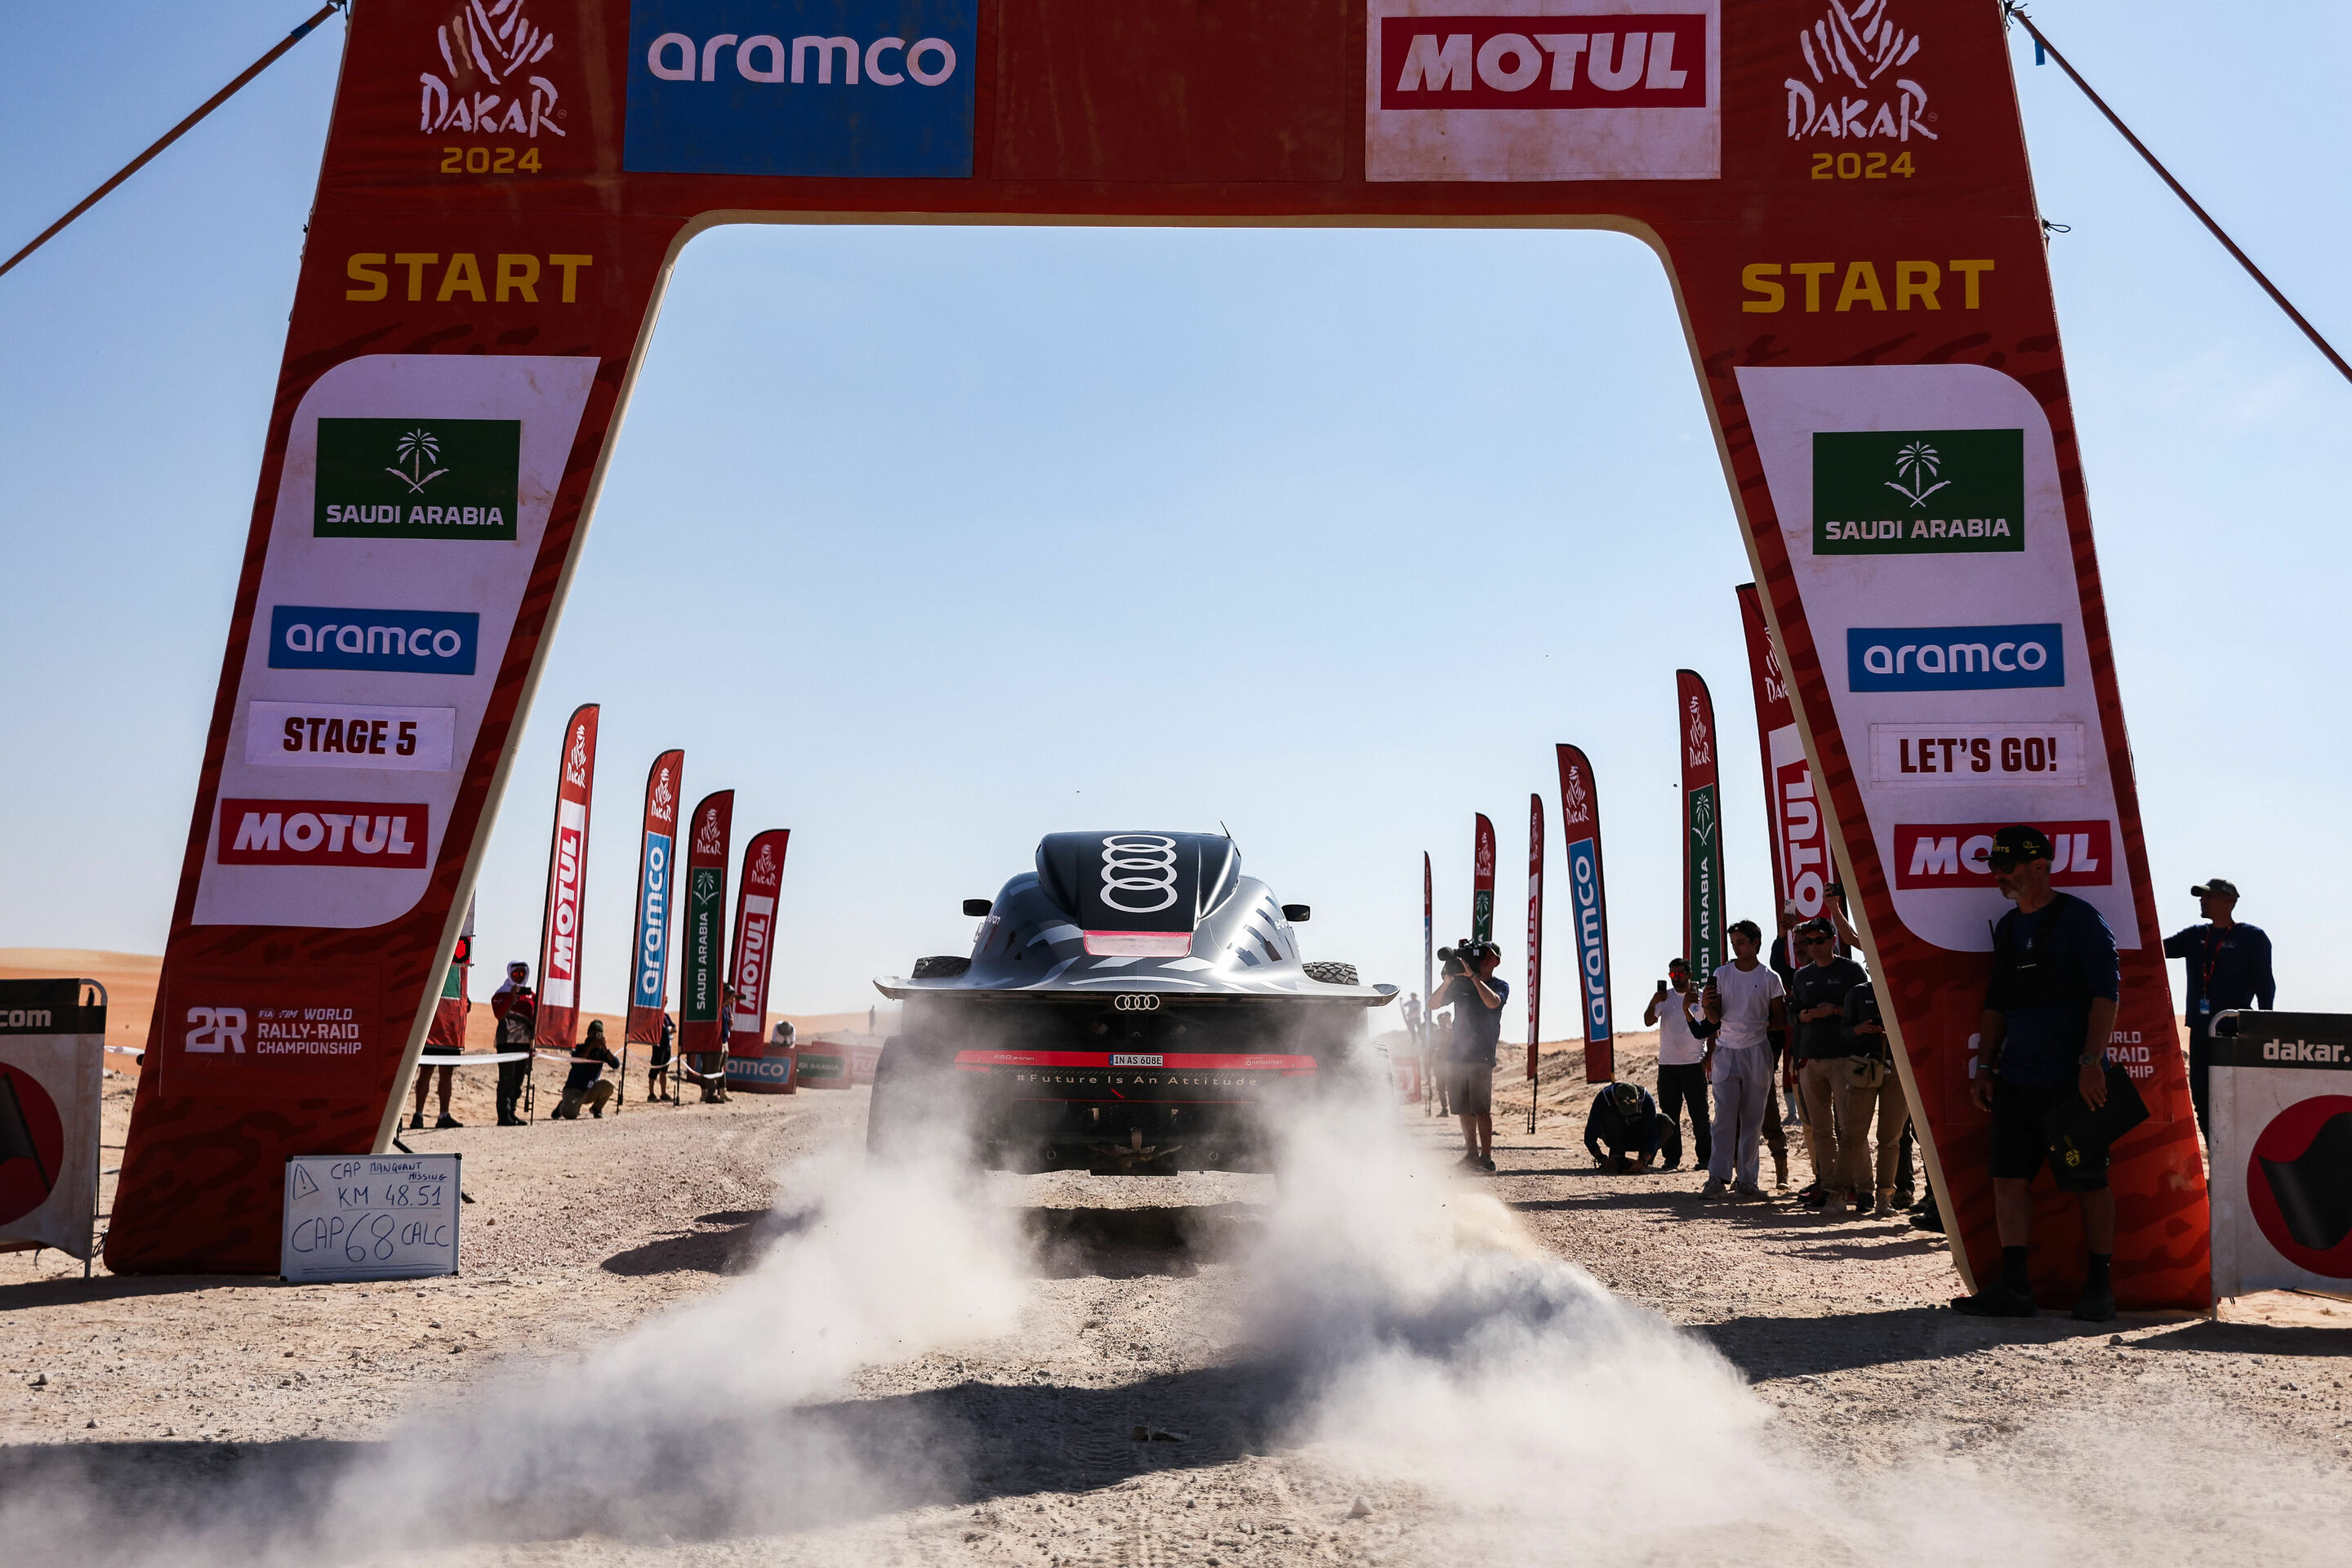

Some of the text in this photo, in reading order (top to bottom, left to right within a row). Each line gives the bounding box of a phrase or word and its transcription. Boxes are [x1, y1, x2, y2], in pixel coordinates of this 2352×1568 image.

[648, 32, 957, 87] aramco
[1396, 31, 1688, 92] MOTUL
[420, 72, 567, 138] DAKAR
[1784, 78, 1938, 142] DAKAR
[440, 147, 543, 174] 2024
[1811, 152, 1916, 180] 2024
[346, 252, 593, 303] START
[1741, 260, 1995, 314] START
[326, 504, 505, 525] SAUDI ARABIA
[1825, 519, 2011, 540] SAUDI ARABIA
[285, 623, 461, 658] aramco
[1863, 641, 2047, 675] aramco
[1764, 676, 1789, 704] DAK
[283, 716, 417, 756] STAGE 5
[1689, 741, 1711, 769] DAKAR
[1900, 737, 2057, 773] LET'S GO!
[567, 762, 586, 789] DAKAR
[652, 802, 673, 824] DAKAR
[1566, 804, 1590, 825] DAKAR
[233, 812, 415, 854] MOTUL
[697, 839, 721, 856] DAKAR
[1785, 768, 1824, 919] OTUL
[1909, 833, 2098, 875] MOUL
[751, 869, 776, 887] DAKAR
[553, 835, 577, 973] MOTUL
[643, 846, 665, 995] aramco
[1699, 857, 1709, 983] ARABIA UDI
[1575, 856, 1606, 1027] aramco
[697, 911, 709, 1010] SAUDI ARABIA
[741, 917, 766, 1010] MOTUL
[305, 1009, 353, 1020] WORLD
[258, 1023, 359, 1039] RALLY-RAID
[257, 1041, 362, 1054] CHAMPIONSHIP
[1115, 1055, 1162, 1065] IN AS 608E
[2263, 1038, 2351, 1063] dakar.
[1017, 1074, 1258, 1085] #Future Is An Attitude
[331, 1161, 423, 1180] CAP MANQUANT
[408, 1173, 448, 1181] MISSING
[338, 1184, 442, 1208] KM 48.51
[292, 1212, 450, 1263] CAP 68 CALC
